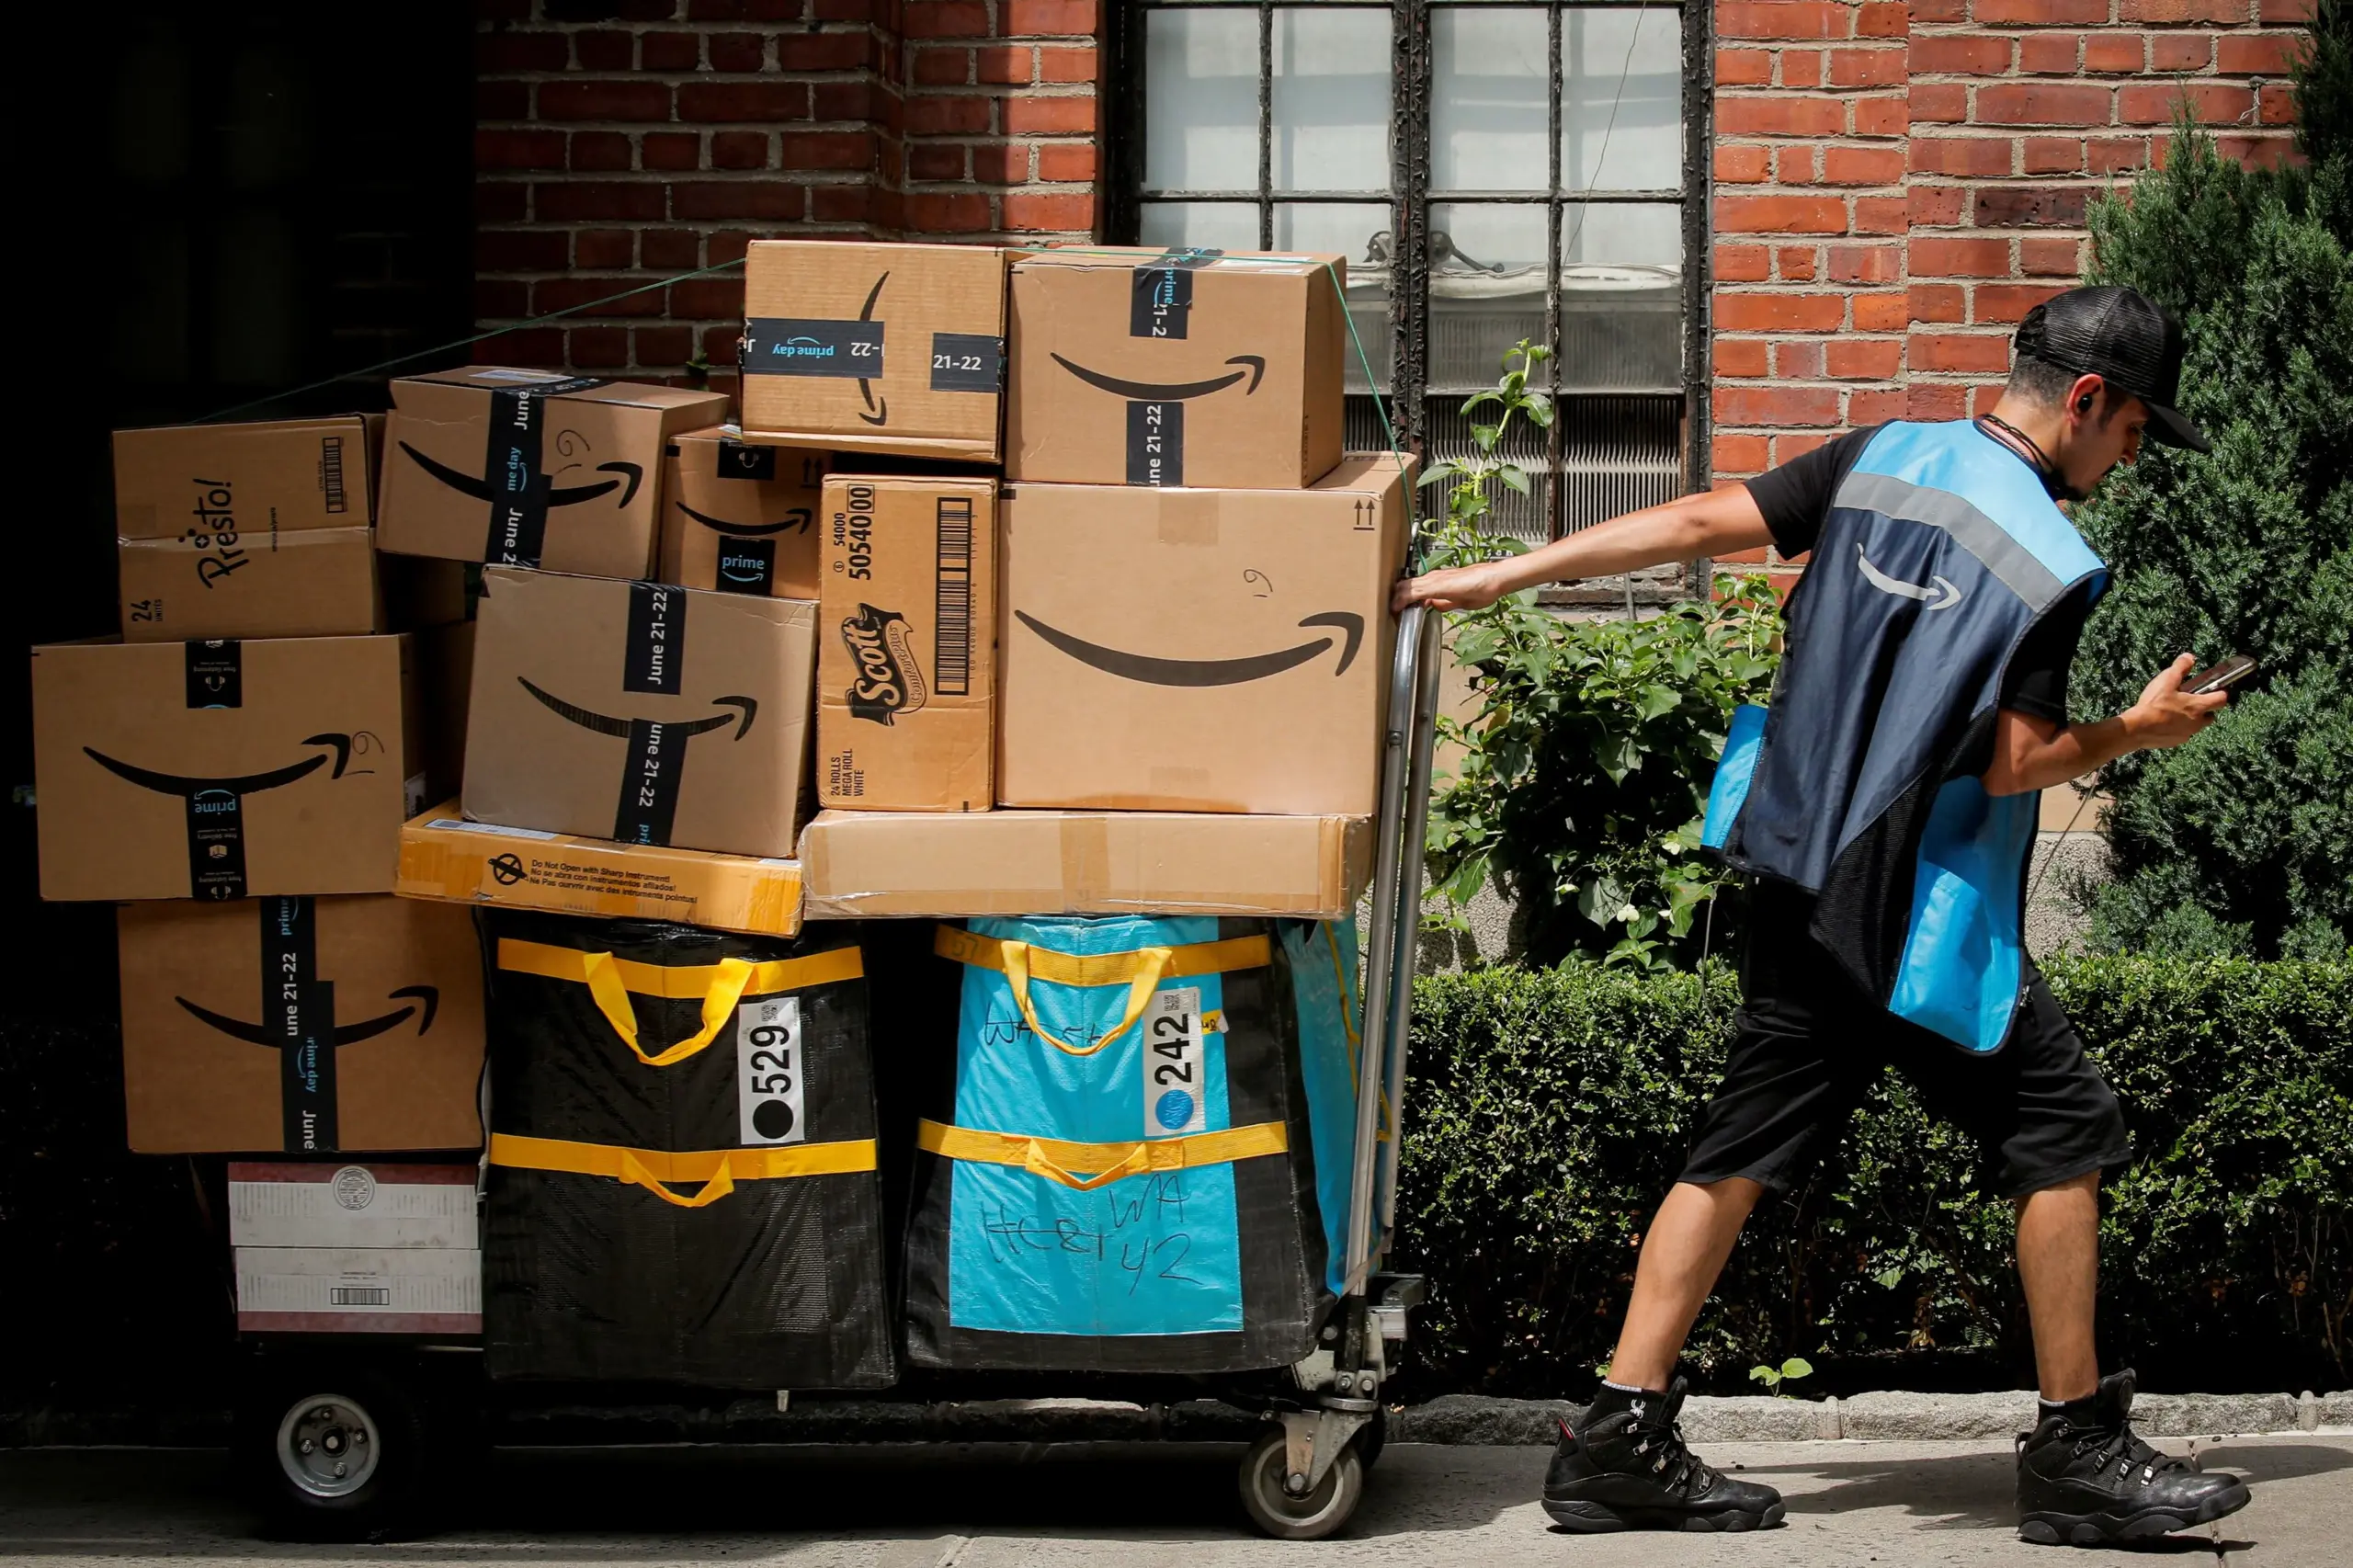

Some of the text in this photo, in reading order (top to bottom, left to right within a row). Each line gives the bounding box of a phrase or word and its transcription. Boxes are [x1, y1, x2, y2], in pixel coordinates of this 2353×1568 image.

[1152, 304, 1168, 339] 1-2
[772, 343, 835, 359] prime day
[932, 354, 983, 371] 21-22
[514, 391, 529, 430] June
[1146, 404, 1162, 453] 21-22
[506, 447, 522, 470] day
[193, 478, 249, 589] Presto!
[505, 508, 523, 548] June
[834, 512, 846, 547] 54000
[848, 487, 872, 581] 50540 00
[722, 555, 765, 570] prime
[131, 599, 152, 622] 24
[647, 591, 668, 685] June 21-22
[843, 623, 901, 706] Scott
[638, 759, 660, 807] 21-22
[831, 756, 841, 796] 24 ROLLS
[842, 748, 853, 796] MEGA ROLL
[854, 769, 864, 797] WHITE
[194, 798, 236, 815] prime
[530, 868, 541, 876] No
[554, 871, 572, 880] abra
[642, 881, 676, 892] afilados!
[531, 859, 543, 868] Do
[545, 861, 559, 869] Not
[560, 863, 581, 872] Open
[600, 868, 625, 878] Sharp
[529, 877, 540, 885] Ne
[541, 878, 556, 887] Pas
[585, 884, 605, 892] avec
[606, 886, 620, 894] des
[665, 893, 698, 903] pointus!
[282, 952, 298, 1000] 21-22
[305, 1037, 319, 1093] rime day
[749, 1025, 791, 1094] 529
[1153, 1013, 1192, 1085] 242
[302, 1109, 317, 1150] June
